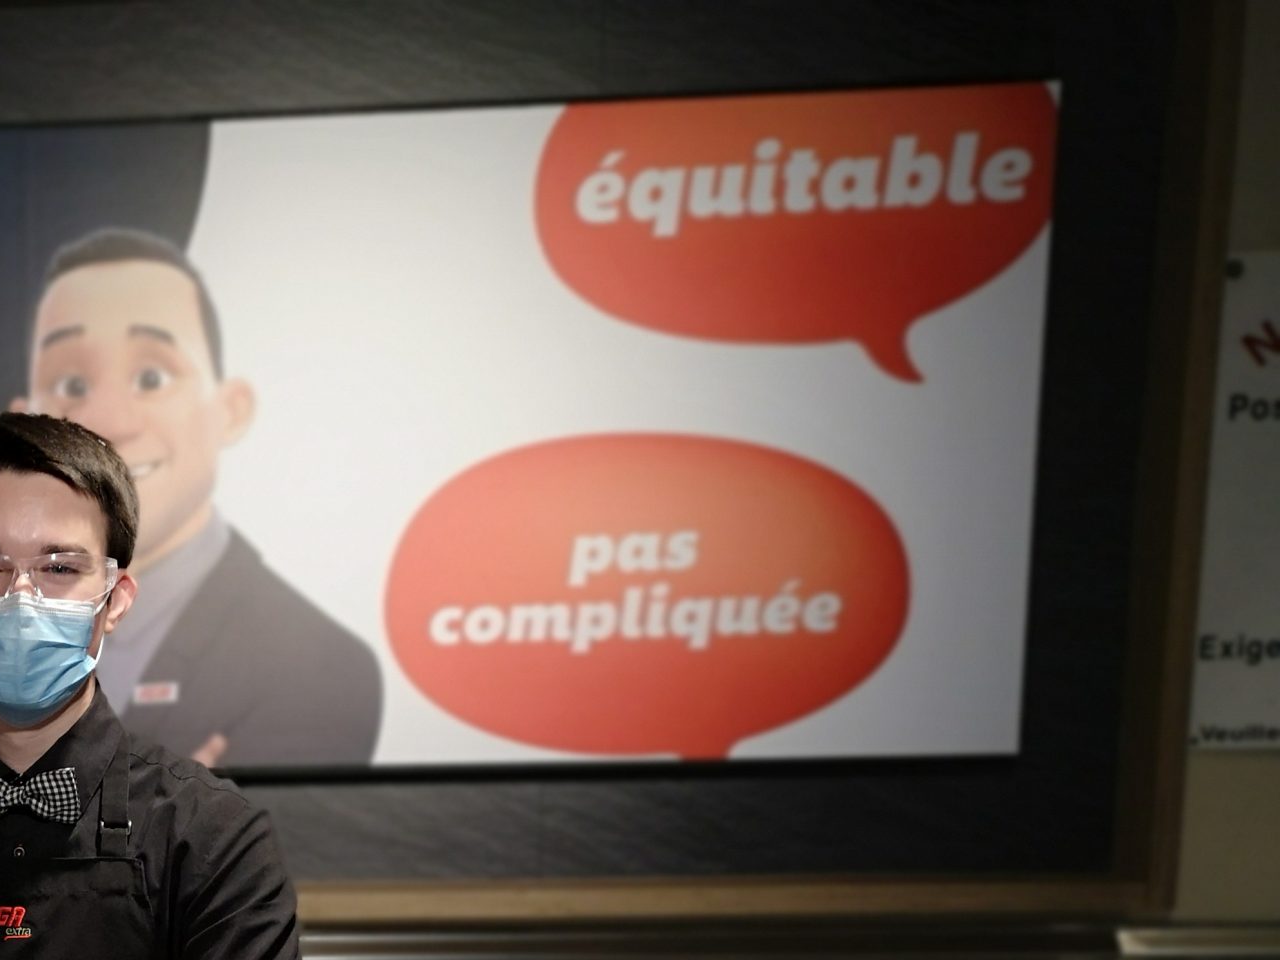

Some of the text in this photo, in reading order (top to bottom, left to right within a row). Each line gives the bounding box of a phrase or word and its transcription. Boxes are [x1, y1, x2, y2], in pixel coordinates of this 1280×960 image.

[575, 131, 1034, 238] équitable
[567, 529, 700, 586] pas
[428, 579, 843, 655] compliquée
[5, 926, 32, 936] extra
